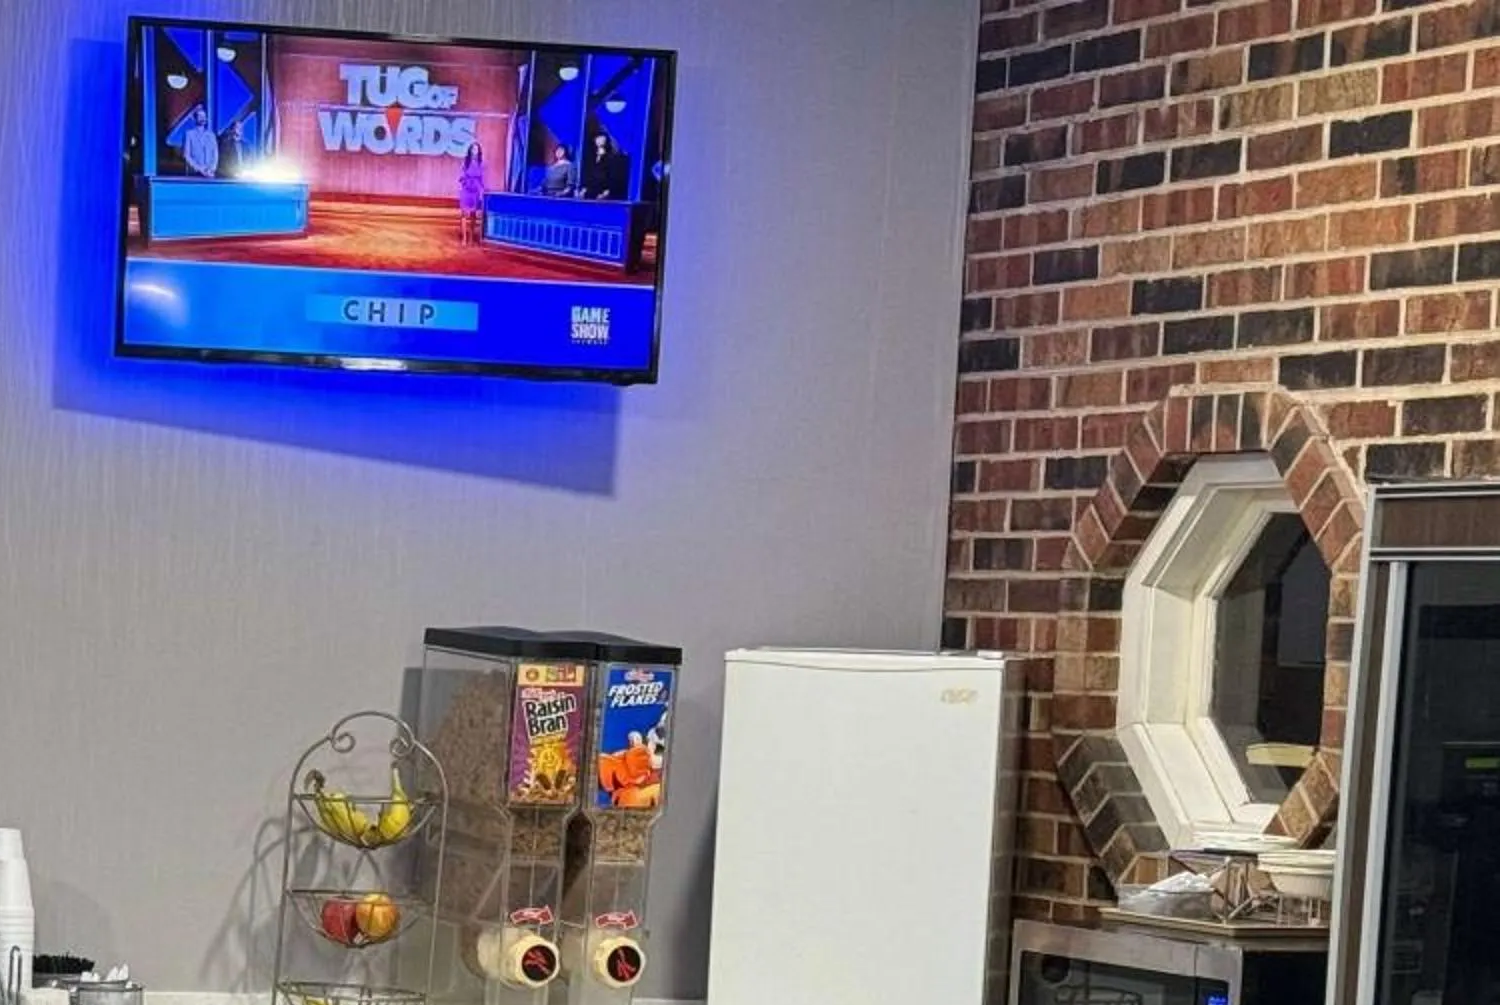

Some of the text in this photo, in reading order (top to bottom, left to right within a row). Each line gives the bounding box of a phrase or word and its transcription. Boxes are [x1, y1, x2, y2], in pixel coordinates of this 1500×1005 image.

[339, 63, 459, 109] TUG OF
[317, 111, 478, 158] WORDS
[343, 299, 436, 325] CHIP
[571, 323, 610, 339] SHOW
[608, 681, 663, 698] FROSTED
[526, 696, 575, 719] Raisin
[528, 716, 567, 736] Bran
